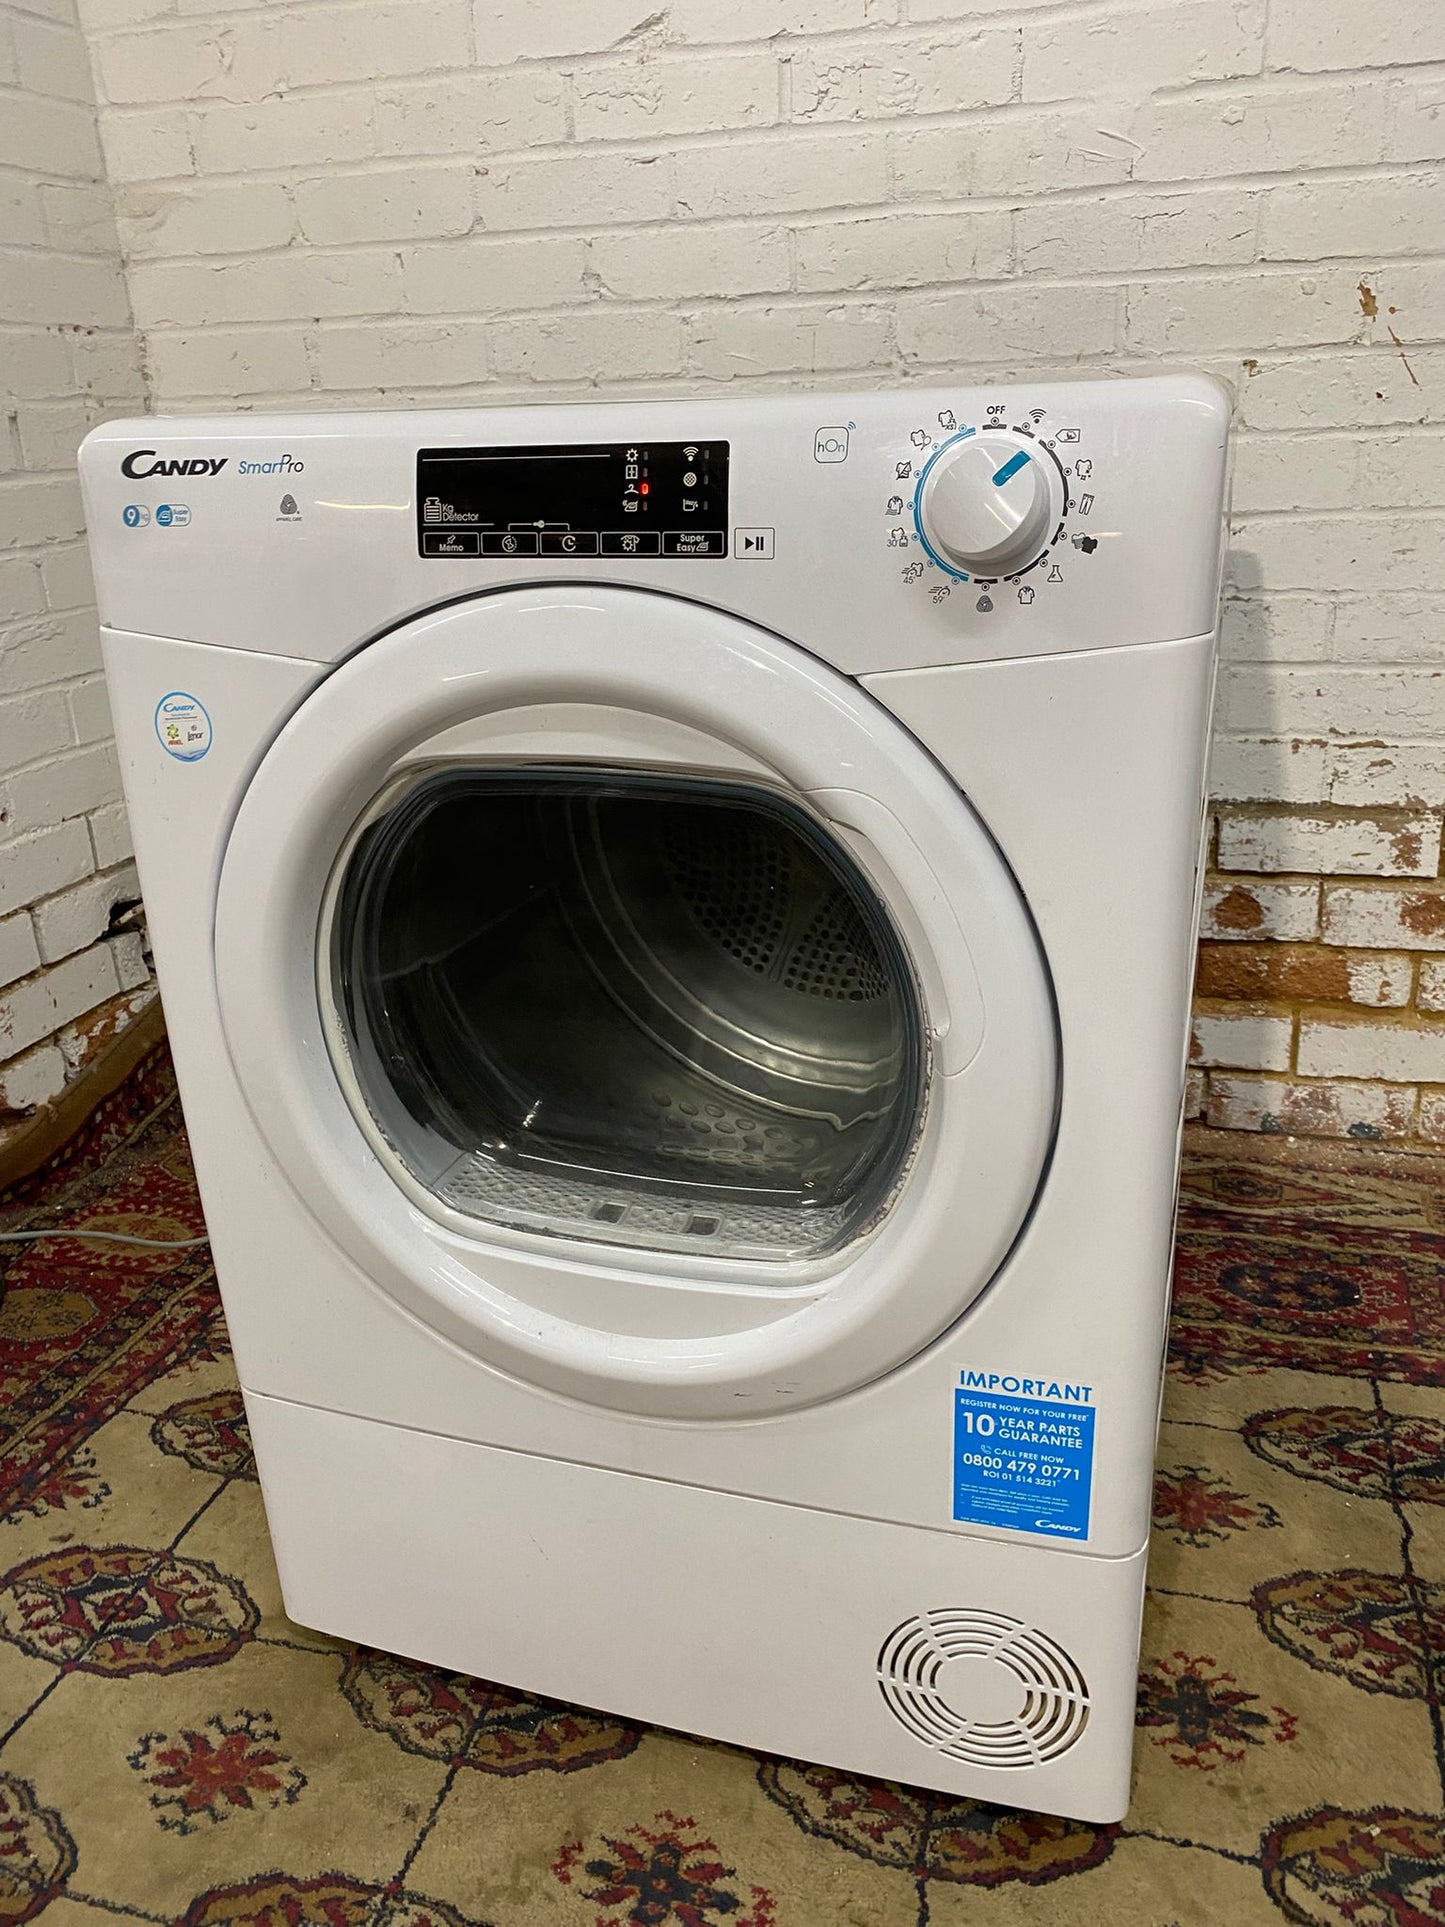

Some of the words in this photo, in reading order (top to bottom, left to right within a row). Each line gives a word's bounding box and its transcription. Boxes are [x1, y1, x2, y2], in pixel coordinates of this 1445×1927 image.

[986, 405, 1006, 415] OFF
[817, 438, 845, 453] hOn
[121, 449, 229, 480] CANDY
[442, 503, 454, 514] Kg
[442, 512, 479, 522] Detector
[680, 533, 705, 544] Super
[439, 543, 464, 552] Memo
[676, 543, 696, 553] Easy
[960, 1370, 1092, 1402] IMPORTANT
[960, 1398, 997, 1409] REGISTER
[999, 1404, 1021, 1413] NOW
[1023, 1407, 1040, 1415] FOR
[1042, 1410, 1066, 1419] YOUR
[963, 1411, 995, 1436] 10
[999, 1416, 1035, 1431] YEAR
[1039, 1422, 1081, 1437] PARTS
[998, 1428, 1083, 1449] GUARANTEE
[994, 1448, 1016, 1458] CALL
[1019, 1452, 1039, 1461] FREE
[1041, 1455, 1064, 1464] NOW
[963, 1453, 1002, 1469] 0800
[1007, 1460, 1036, 1474] 479
[1041, 1465, 1080, 1480] 0771
[983, 1470, 1000, 1479] ROI
[1016, 1475, 1033, 1484] 514
[1035, 1519, 1081, 1533] CANDY
